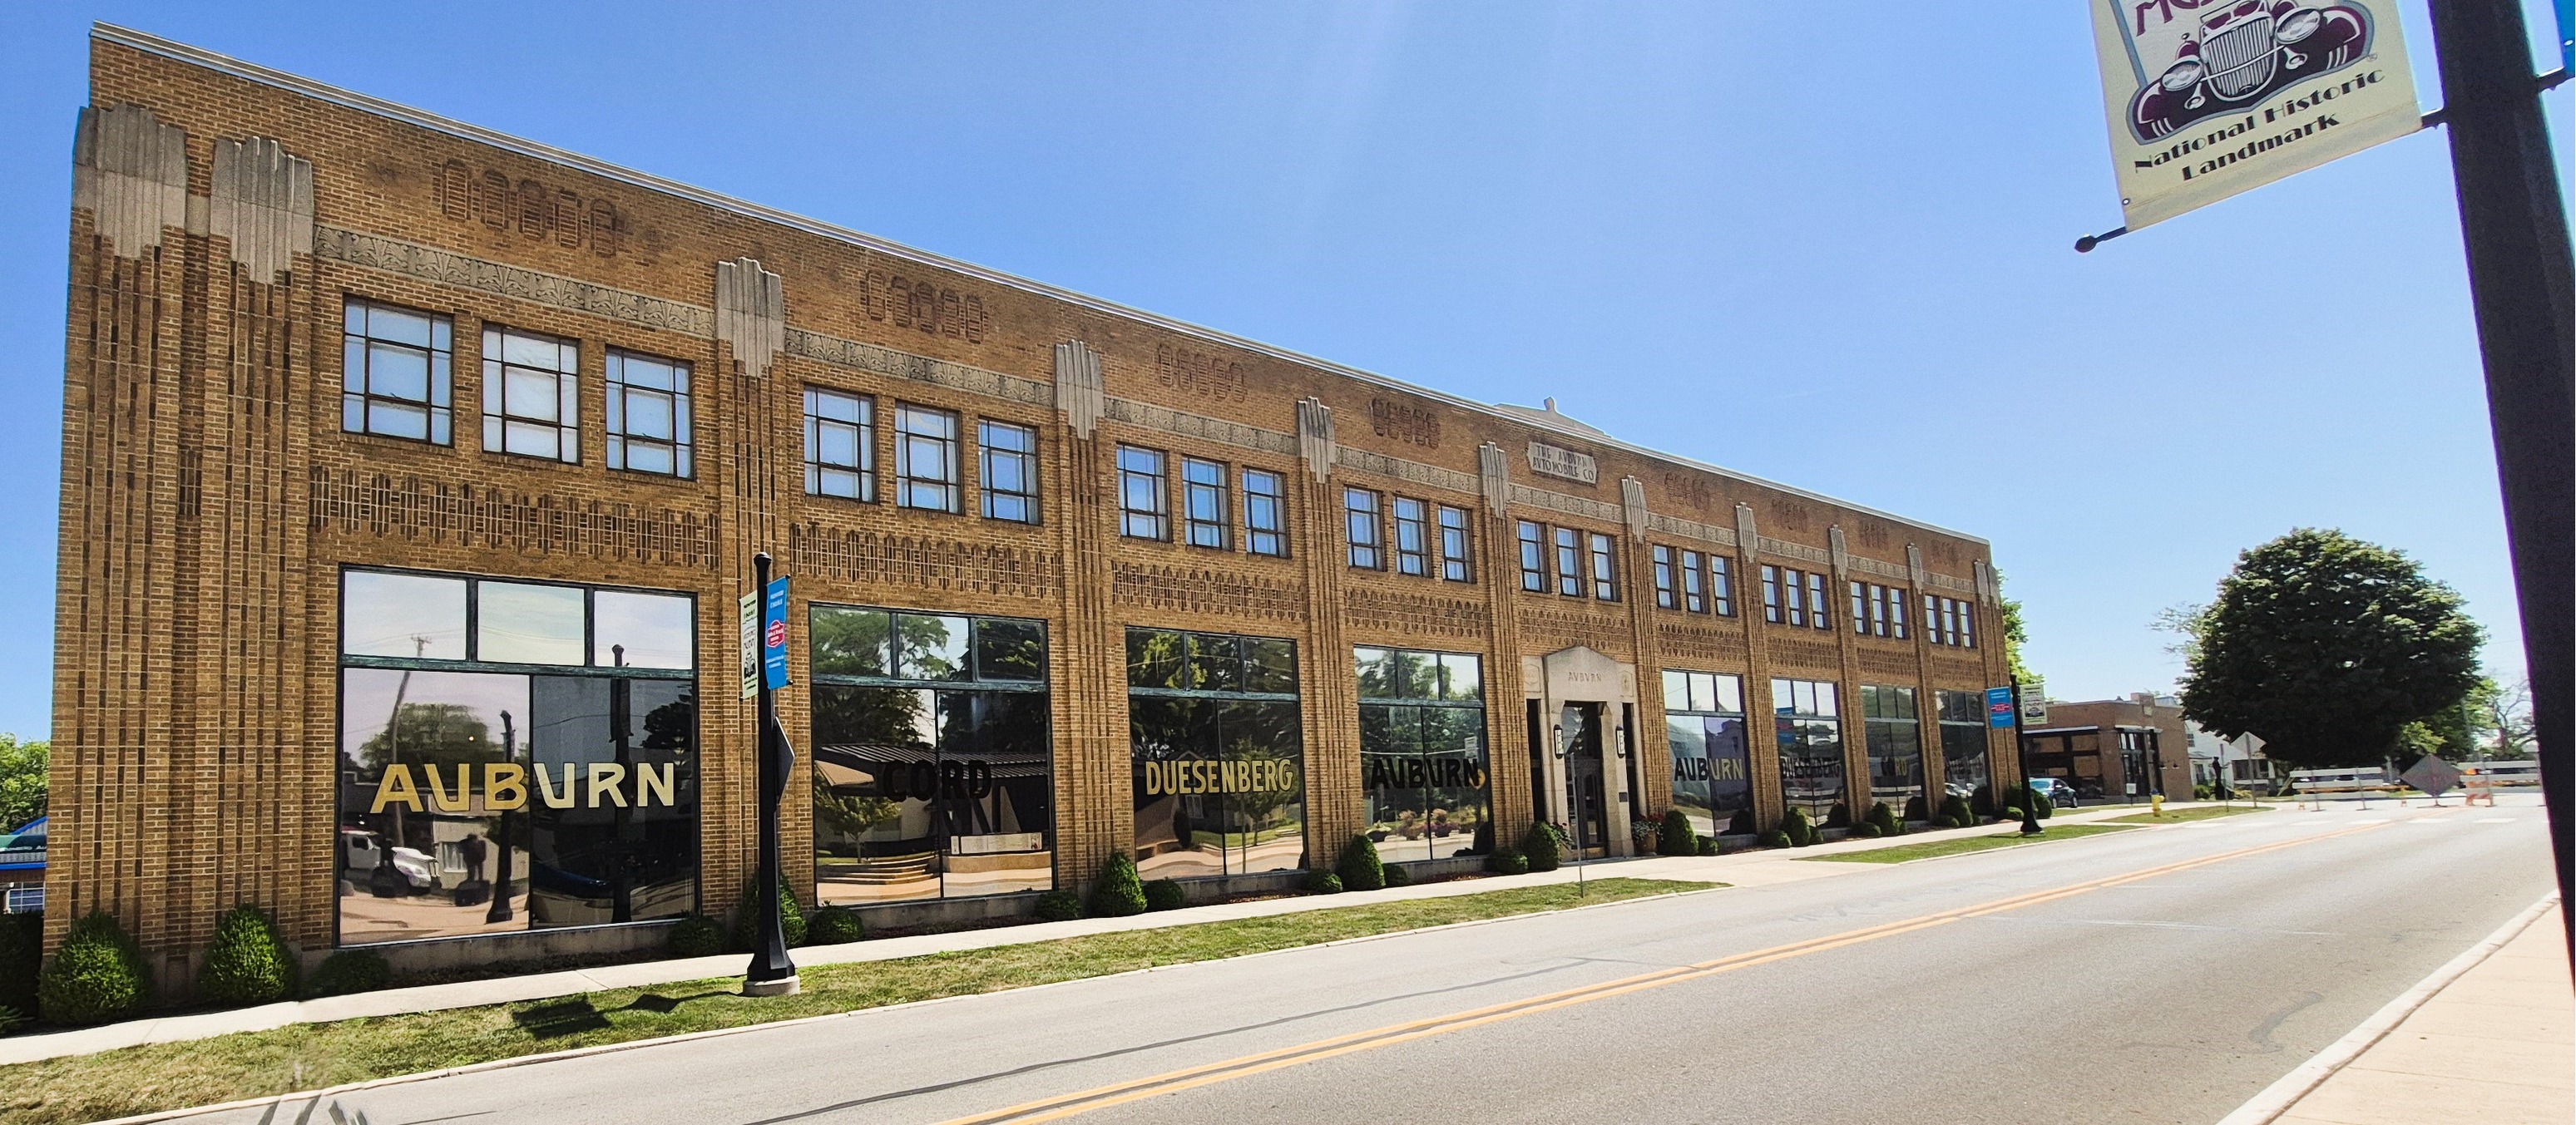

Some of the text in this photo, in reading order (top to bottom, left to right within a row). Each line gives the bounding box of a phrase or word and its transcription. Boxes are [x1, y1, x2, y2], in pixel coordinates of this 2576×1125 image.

[2134, 69, 2386, 174] National Historic
[2182, 113, 2341, 181] Landmark
[1536, 445, 1552, 459] THE
[369, 762, 675, 814] AUBURN
[883, 759, 992, 802] CORD
[1145, 758, 1294, 796] DUESENBERG
[1370, 757, 1481, 790] AUBURN
[1674, 757, 1744, 782] AUBURN
